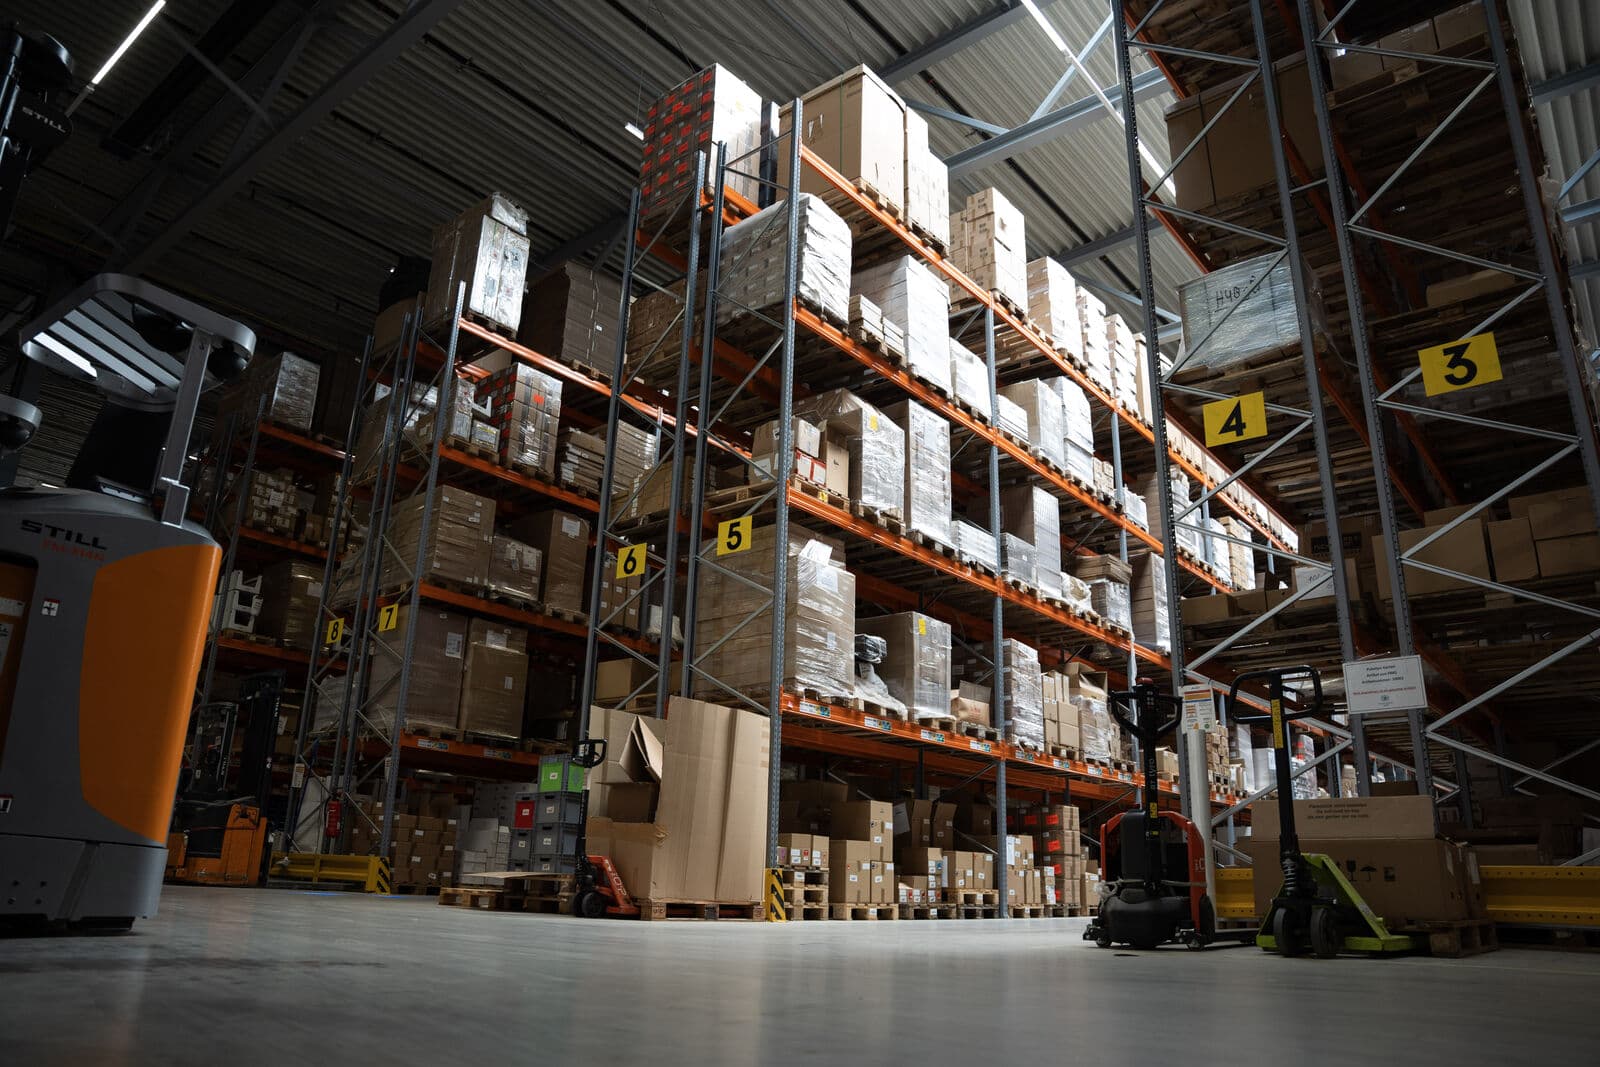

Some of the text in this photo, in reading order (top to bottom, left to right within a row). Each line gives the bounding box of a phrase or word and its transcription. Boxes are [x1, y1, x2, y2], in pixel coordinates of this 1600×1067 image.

[22, 106, 67, 133] STILL
[1443, 341, 1478, 386] 3
[1218, 399, 1247, 437] 4
[20, 519, 107, 551] STILL
[726, 521, 741, 550] 5
[623, 548, 637, 575] 6
[330, 620, 340, 641] 8
[384, 607, 394, 630] 7
